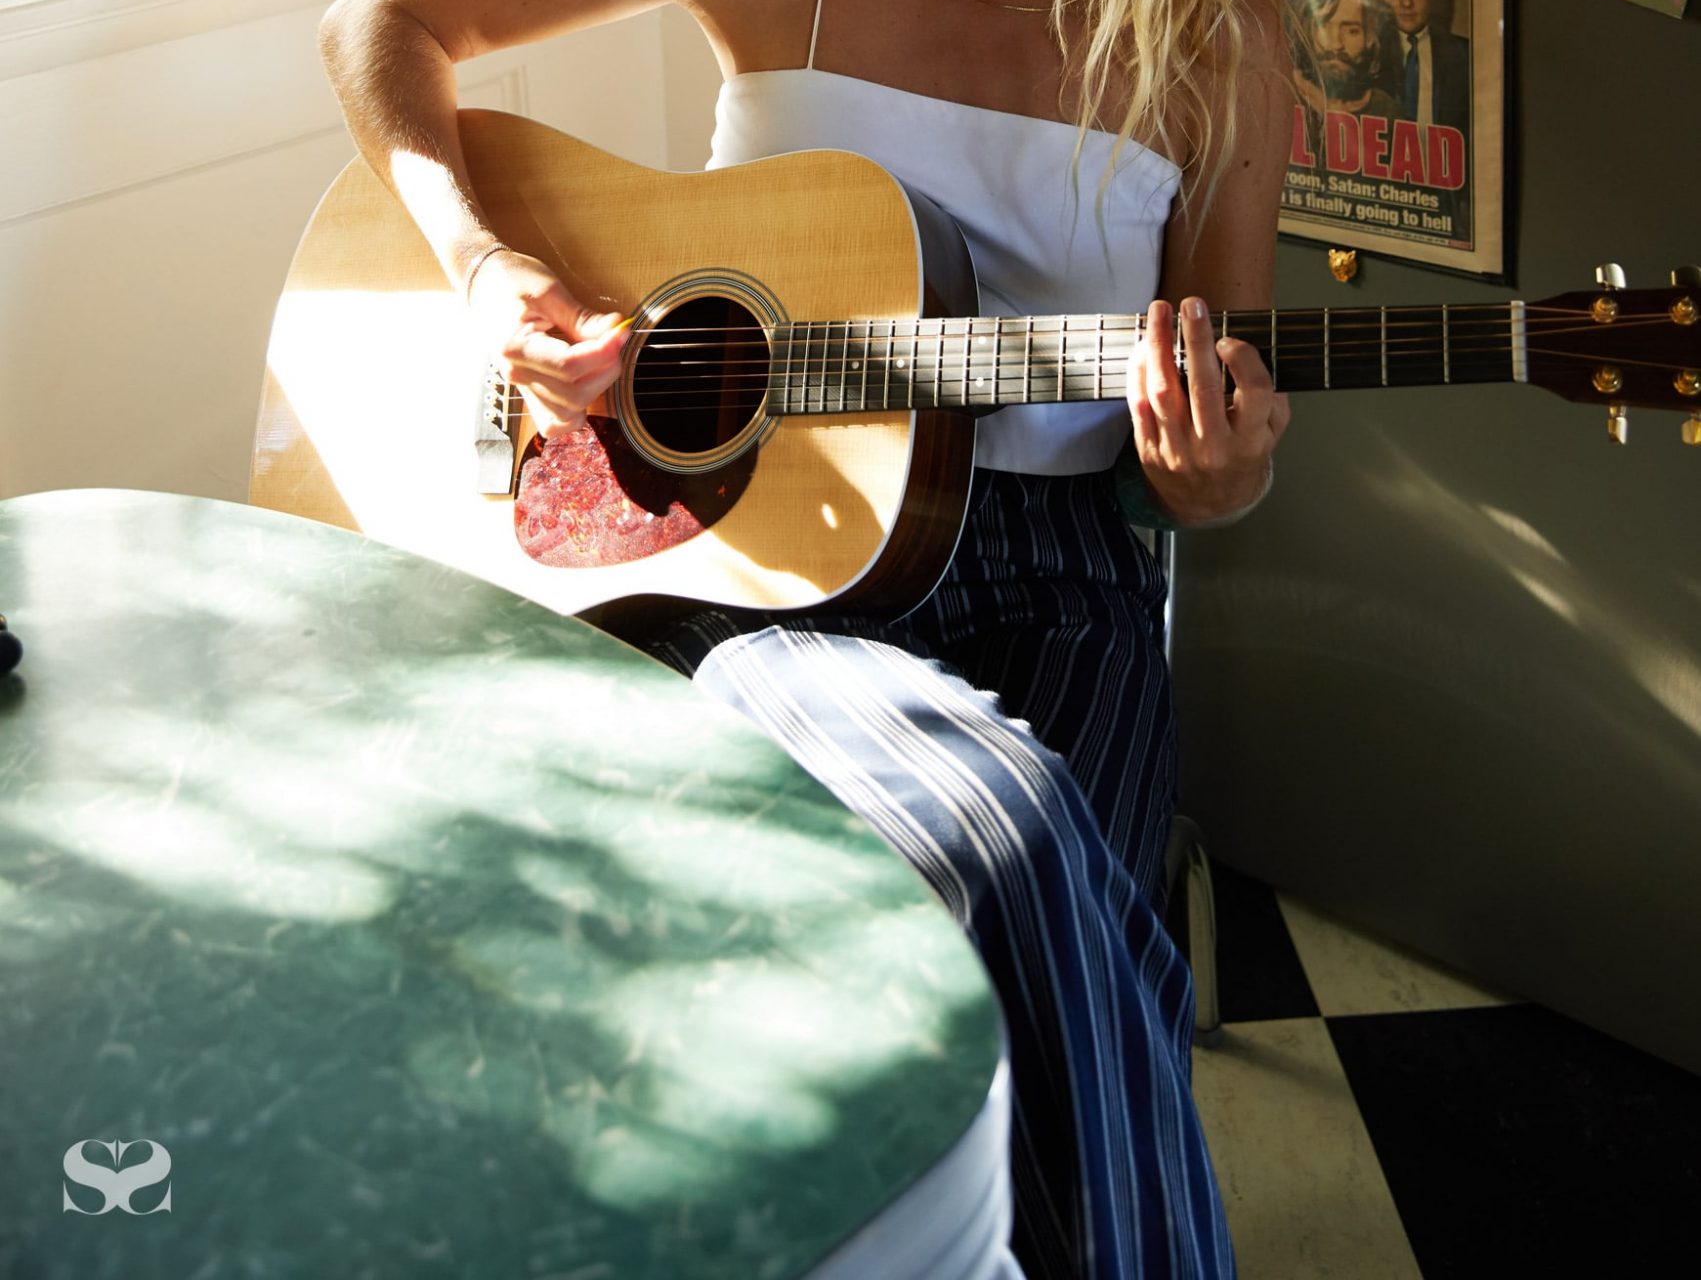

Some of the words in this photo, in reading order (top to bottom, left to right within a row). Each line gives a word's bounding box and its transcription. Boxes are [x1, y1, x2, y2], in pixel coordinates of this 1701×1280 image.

[1325, 110, 1466, 191] DEAD
[1289, 190, 1302, 206] is
[1306, 193, 1352, 217] finally
[1356, 202, 1399, 226] going
[1403, 209, 1419, 227] to
[1422, 213, 1452, 232] hell
[1328, 176, 1376, 199] Satan:
[1379, 184, 1439, 208] Charles
